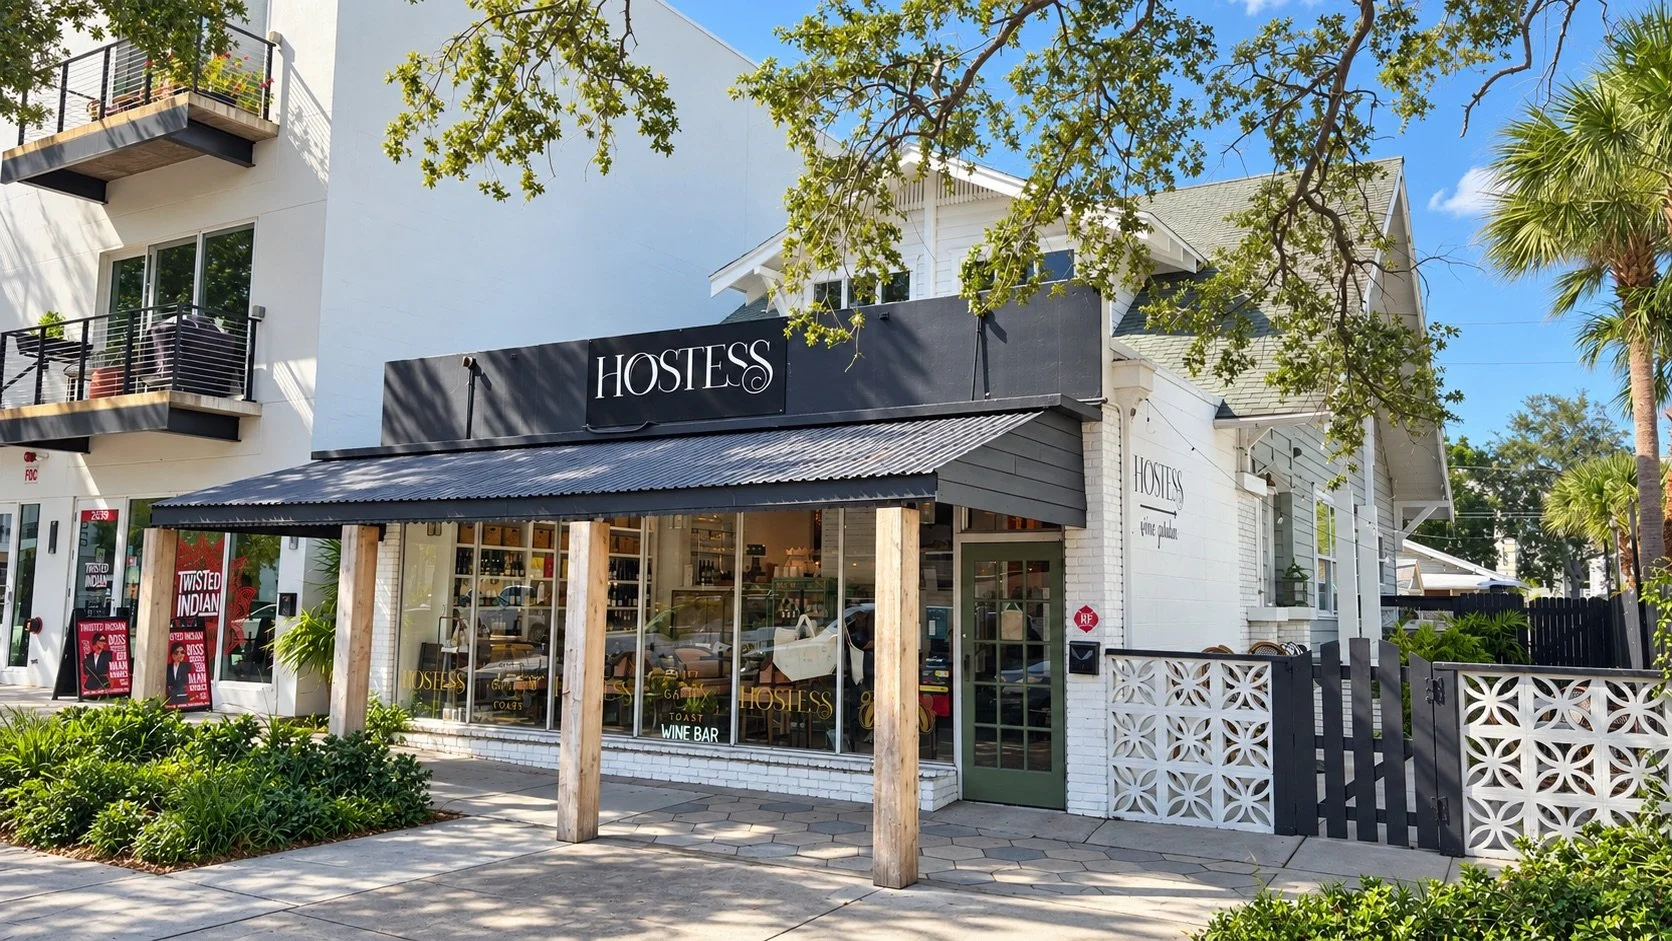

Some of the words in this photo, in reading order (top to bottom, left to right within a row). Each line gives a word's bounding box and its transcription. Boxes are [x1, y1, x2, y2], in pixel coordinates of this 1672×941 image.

[595, 339, 774, 399] HOSTESS
[1134, 455, 1184, 511] HOSTESS
[178, 570, 221, 593] TWISTED
[177, 593, 220, 617] INDIAN
[401, 670, 466, 695] HOSTESS
[739, 685, 833, 720] HOSTESS
[669, 712, 704, 723] TOAST
[661, 723, 691, 740] WINE
[693, 726, 719, 742] BAR
